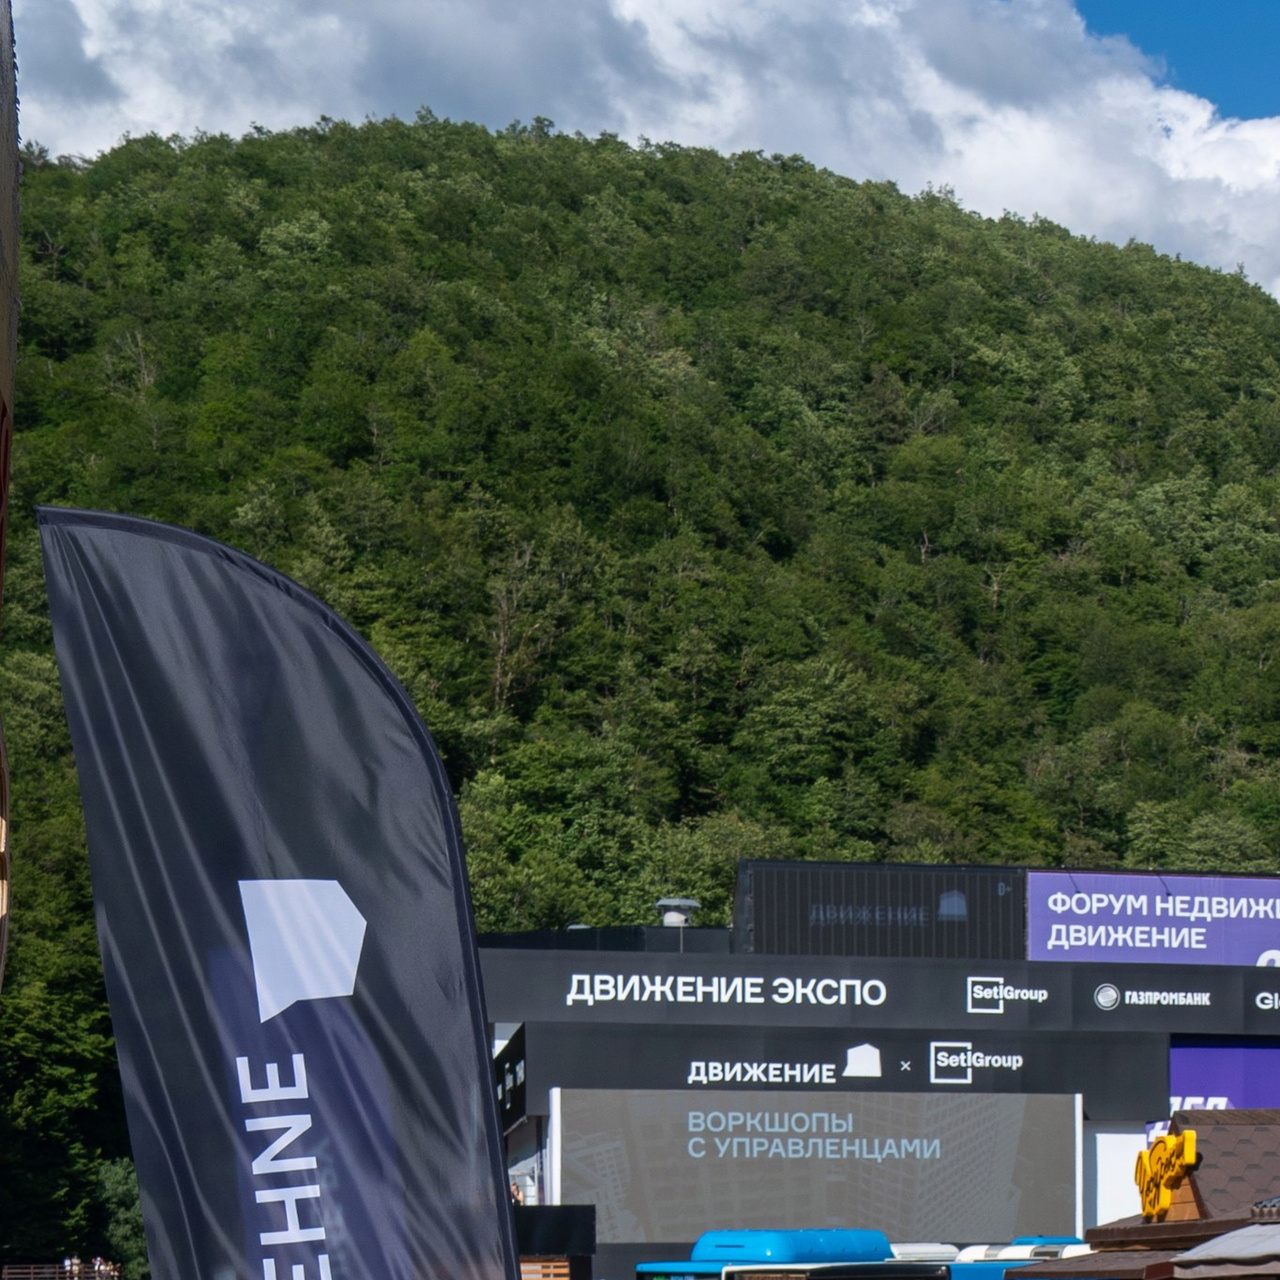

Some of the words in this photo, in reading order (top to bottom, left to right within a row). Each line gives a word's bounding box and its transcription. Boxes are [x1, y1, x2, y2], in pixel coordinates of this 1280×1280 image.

[808, 903, 930, 928] ДВИЖЕНИЕ
[1047, 891, 1150, 917] ФОРУМ
[1047, 924, 1207, 950] ДВИЖЕНИЕ
[566, 973, 765, 1006] ДВИЖЕНИЕ
[771, 976, 888, 1006] ЭКСПО
[1124, 990, 1211, 1007] ГАЗПРОМБАНК
[688, 1061, 837, 1084] ДВИЖЕНИЕ
[687, 1111, 854, 1134] ВОРКШОПЫ
[687, 1136, 706, 1158] С
[716, 1137, 941, 1162] УПРАВЛЕНЦАМИ
